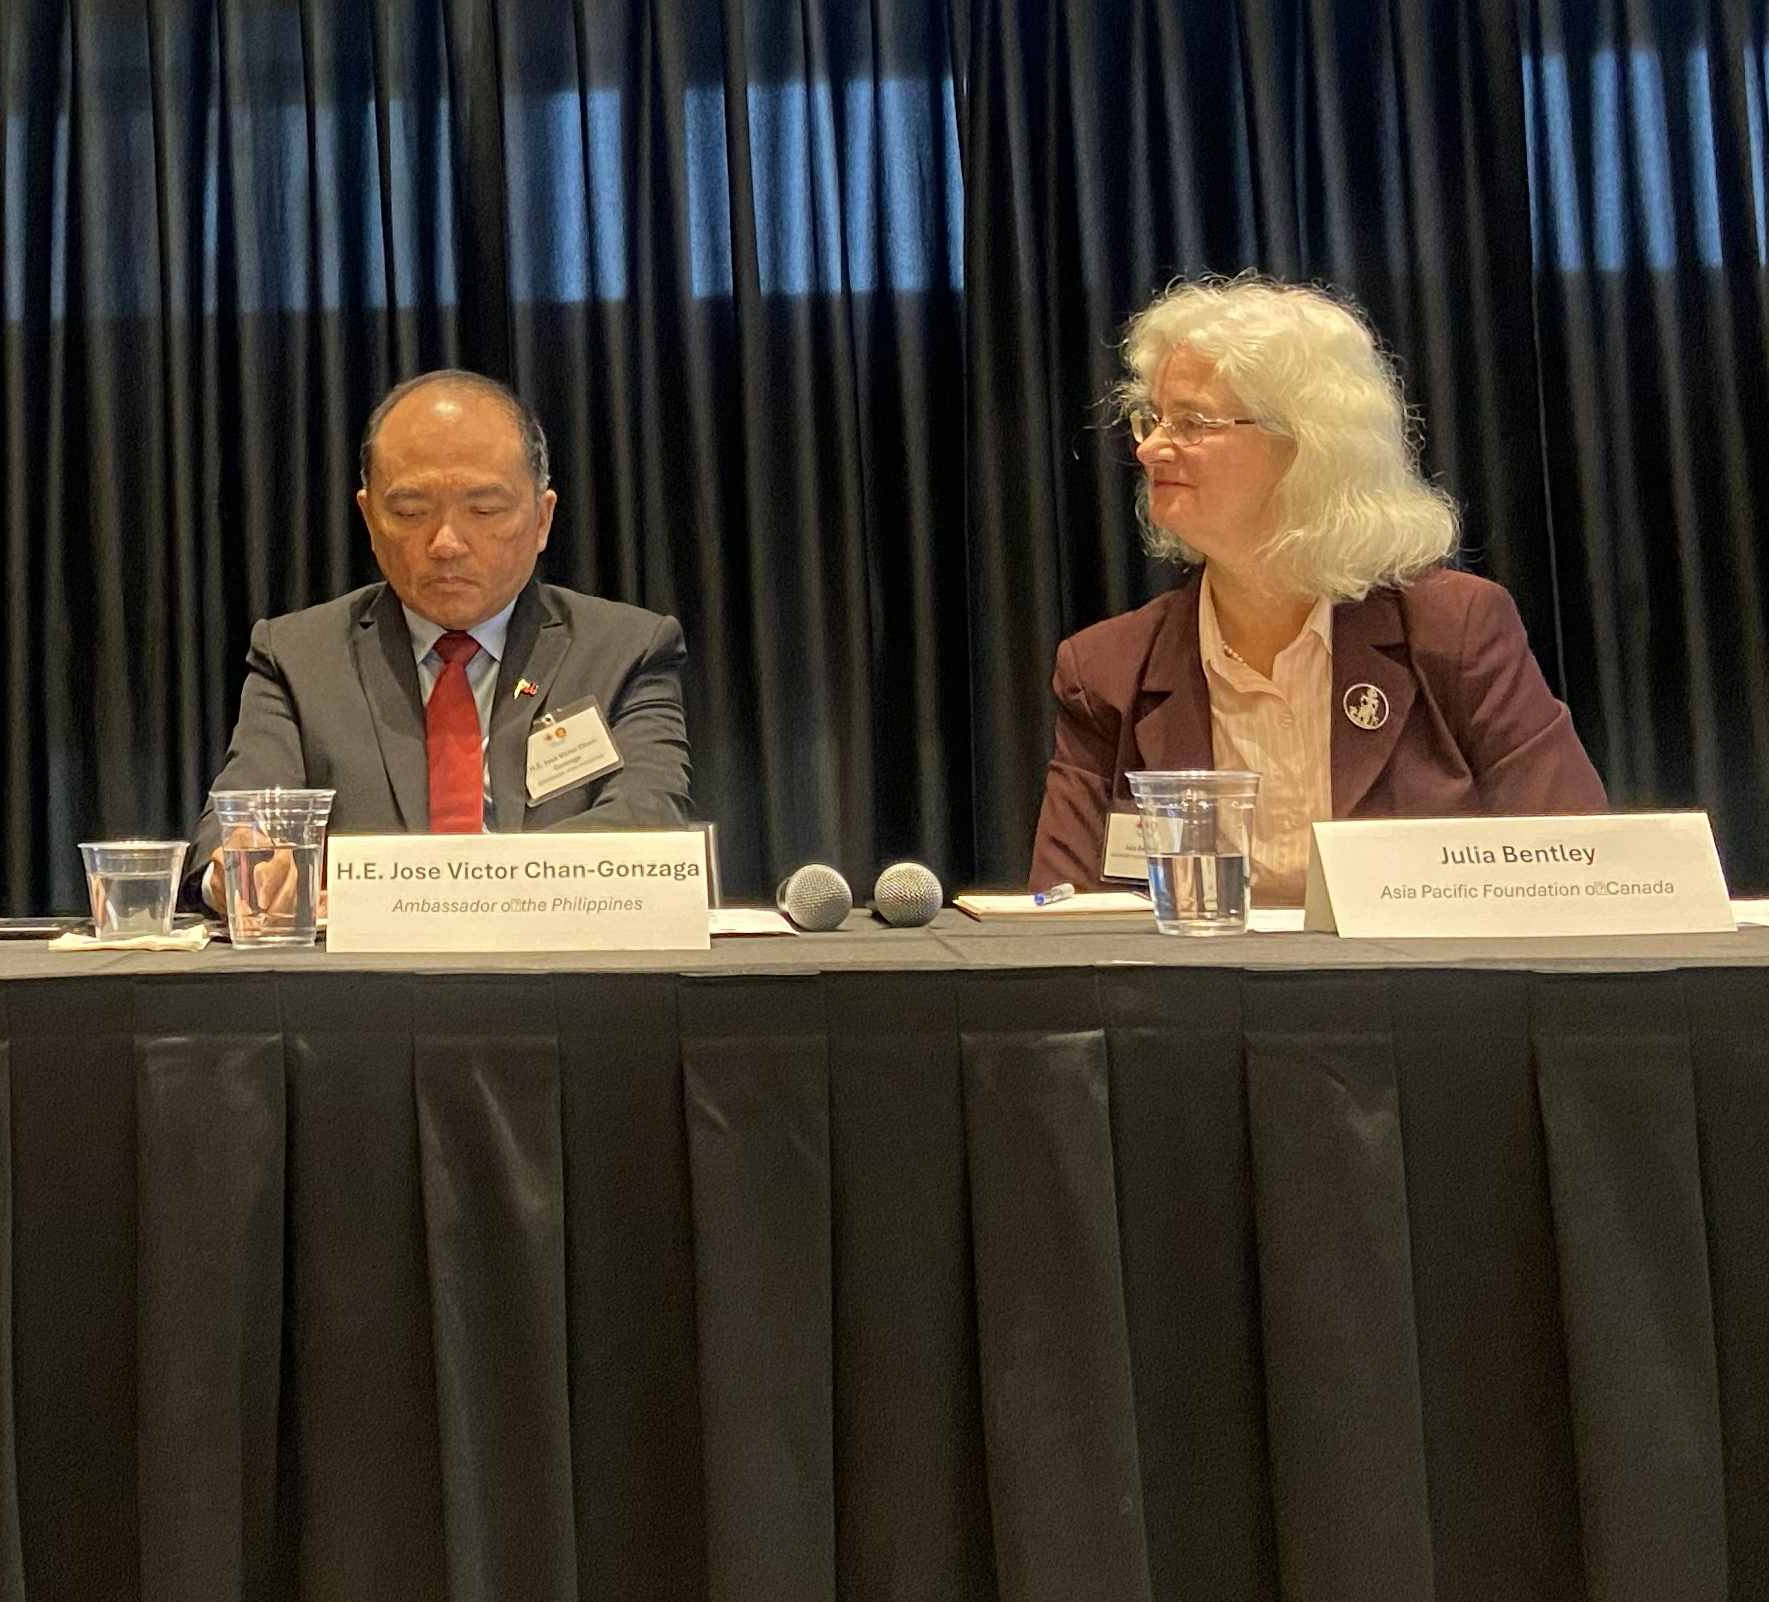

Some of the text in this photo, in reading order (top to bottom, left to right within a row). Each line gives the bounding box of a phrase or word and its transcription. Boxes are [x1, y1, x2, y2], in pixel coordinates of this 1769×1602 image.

[1441, 844, 1596, 866] Julia Bentley
[336, 860, 700, 881] H.E. Jose Victor Chan-Gonzaga
[1380, 885, 1417, 899] Asia
[1421, 883, 1479, 898] Pacific
[1483, 882, 1580, 897] Foundation
[392, 899, 497, 912] Ambassador
[551, 897, 643, 913] Philippines
